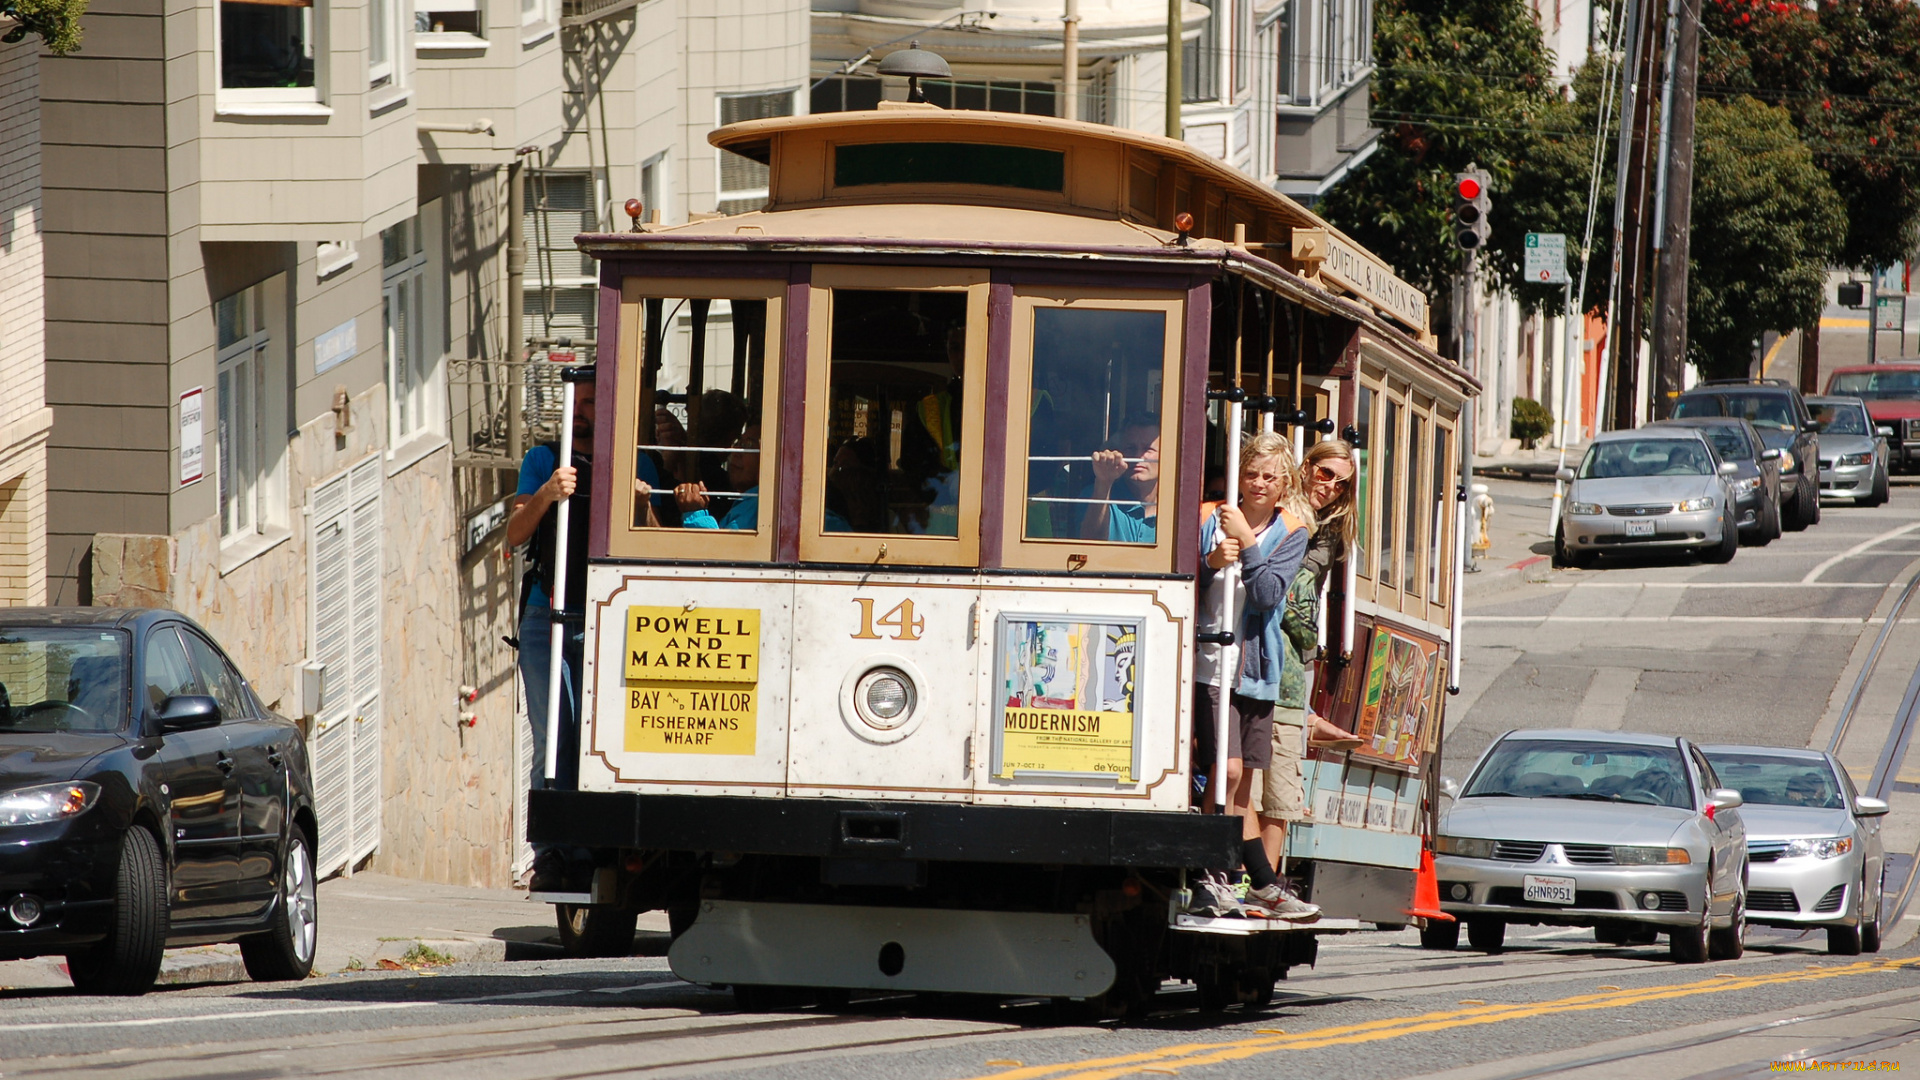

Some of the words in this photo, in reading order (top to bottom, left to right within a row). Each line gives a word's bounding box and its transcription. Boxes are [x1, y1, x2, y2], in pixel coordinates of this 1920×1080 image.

[1528, 235, 1536, 247] 2
[1365, 265, 1372, 293] &
[1375, 271, 1407, 312] MASON
[636, 616, 751, 636] POWELL
[850, 597, 925, 641] 14
[666, 637, 723, 650] AND
[631, 650, 752, 670] MARKET
[631, 690, 660, 710] BAY
[690, 692, 751, 712] TAYLOR
[641, 715, 739, 731] FISHERMANS
[1005, 711, 1100, 733] MODERNISM
[664, 731, 714, 745] WHARF
[1093, 763, 1106, 771] de
[1527, 885, 1572, 901] 6HNR951
